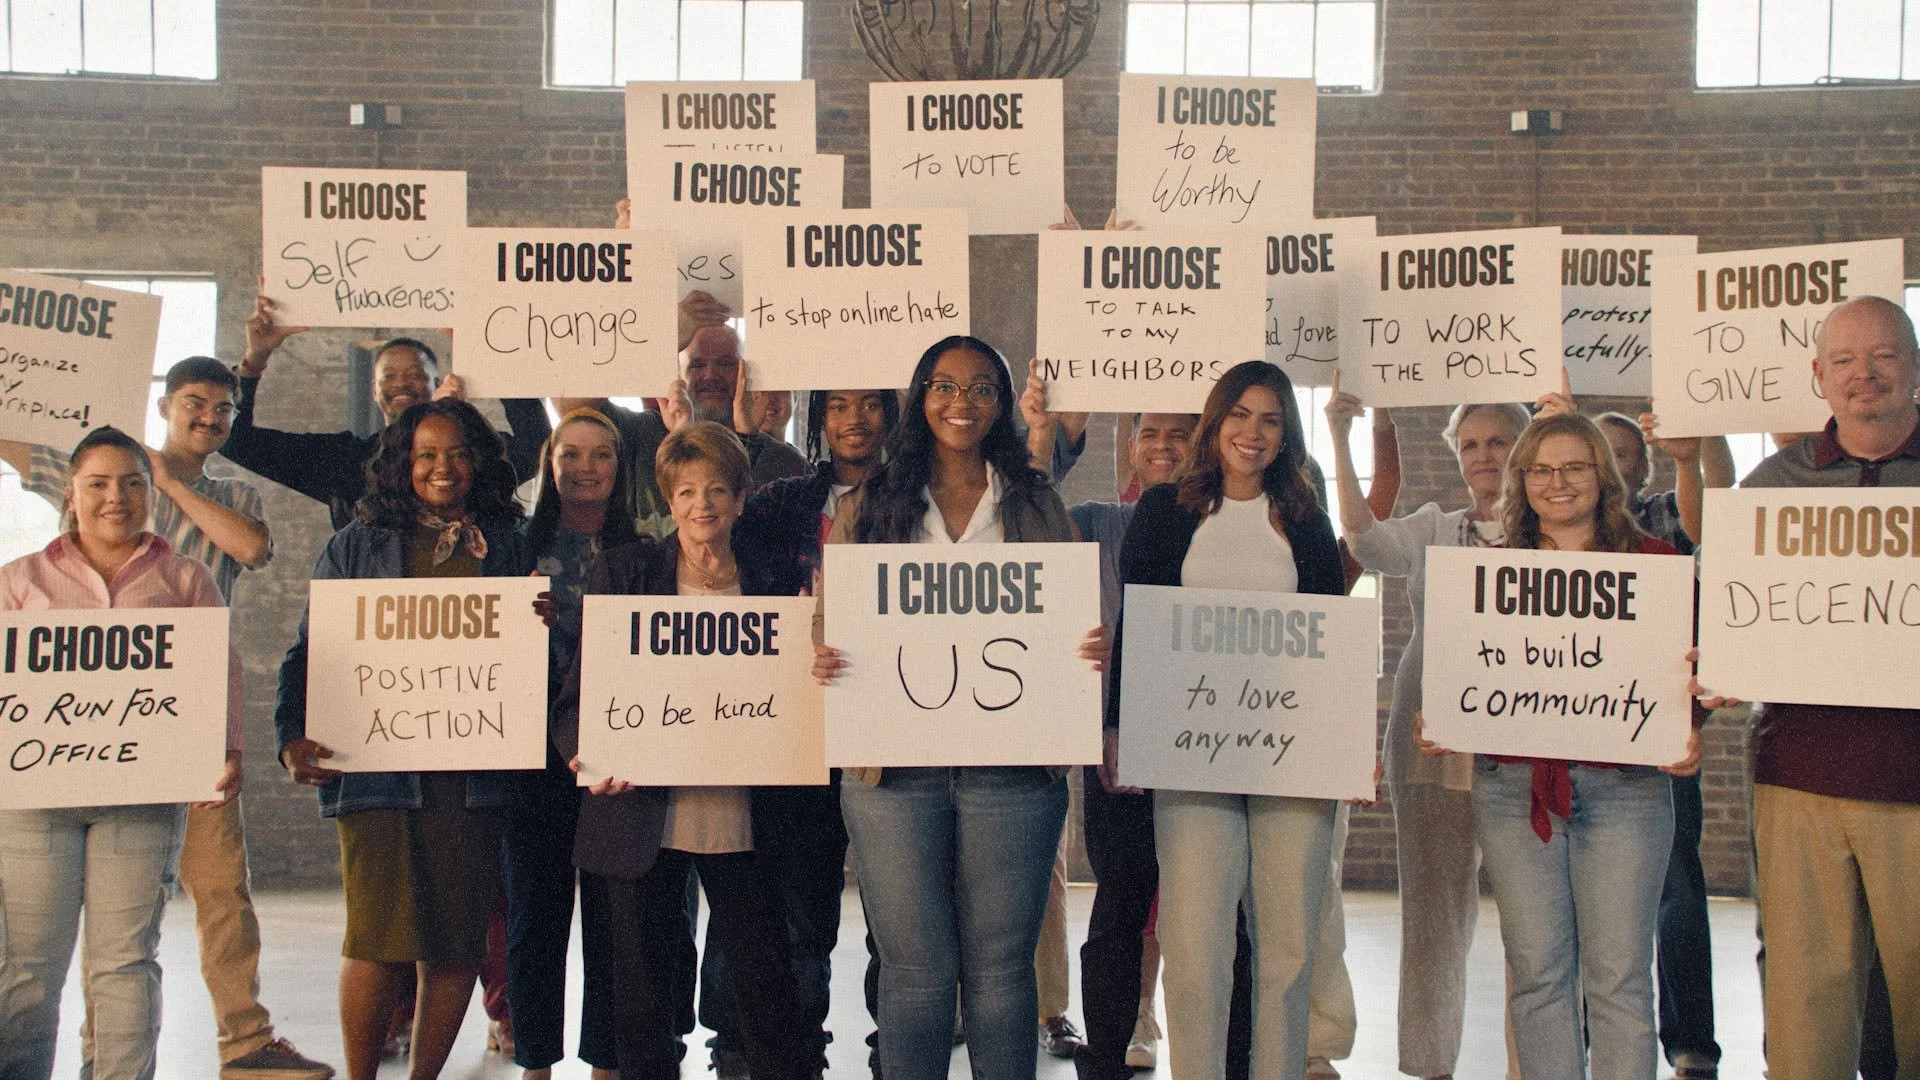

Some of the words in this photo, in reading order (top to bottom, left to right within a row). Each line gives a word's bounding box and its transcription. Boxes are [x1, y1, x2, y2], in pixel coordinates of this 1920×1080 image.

[661, 92, 670, 130] I
[677, 92, 777, 130] CHOOSE
[906, 94, 914, 132] I
[922, 92, 1024, 132] CHOOSE
[1157, 86, 1166, 125] I
[1173, 86, 1277, 127] CHOOSE
[902, 153, 942, 179] to
[954, 151, 1021, 179] VOTE
[1165, 129, 1196, 160] to
[1212, 135, 1241, 165] be
[304, 180, 312, 219] I
[320, 181, 426, 221] CHOOSE
[673, 161, 682, 202] I
[690, 162, 802, 207] CHOOSE
[1152, 164, 1261, 223] Worthy
[281, 238, 377, 290] Self
[497, 242, 507, 282] I
[515, 241, 633, 283] CHOOSE
[786, 225, 795, 268] I
[804, 223, 923, 268] CHOOSE
[1083, 245, 1093, 289] I
[1101, 245, 1222, 290] CHOOSE
[1380, 251, 1389, 292] I
[1397, 243, 1515, 290] CHOOSE
[1697, 269, 1707, 313] I
[1716, 258, 1849, 312] CHOOSE
[750, 296, 775, 329] to
[785, 297, 832, 329] stop
[907, 290, 960, 324] hate
[1085, 300, 1117, 316] TO
[1135, 301, 1197, 316] TALK
[484, 302, 649, 366] Change
[1102, 327, 1133, 339] TO
[1145, 327, 1180, 345] MY
[1362, 317, 1401, 348] TO
[1425, 312, 1522, 344] WORK
[1693, 320, 1745, 354] TO
[1043, 357, 1226, 382] NEIGHBORS
[1372, 362, 1424, 383] THE
[1445, 348, 1538, 380] POLLS
[1685, 366, 1784, 404] GIVE
[1754, 506, 1767, 557] I
[877, 562, 889, 616] I
[899, 561, 1044, 616] CHOOSE
[1474, 565, 1486, 614] I
[1495, 565, 1638, 622] CHOOSE
[355, 595, 367, 641] I
[375, 593, 502, 641] CHOOSE
[630, 611, 640, 656] I
[649, 610, 780, 657] CHOOSE
[1171, 603, 1183, 652] I
[1191, 604, 1326, 660] CHOOSE
[5, 627, 18, 674] I
[28, 624, 175, 673] CHOOSE
[1477, 639, 1506, 668] to
[1524, 632, 1603, 669] build
[354, 662, 502, 695] POSITIVE
[897, 637, 1029, 712] US
[1187, 674, 1217, 711] to
[1237, 678, 1300, 711] love
[365, 701, 505, 746] ACTION
[605, 696, 645, 731] to
[661, 693, 696, 727] be
[714, 692, 778, 721] kind
